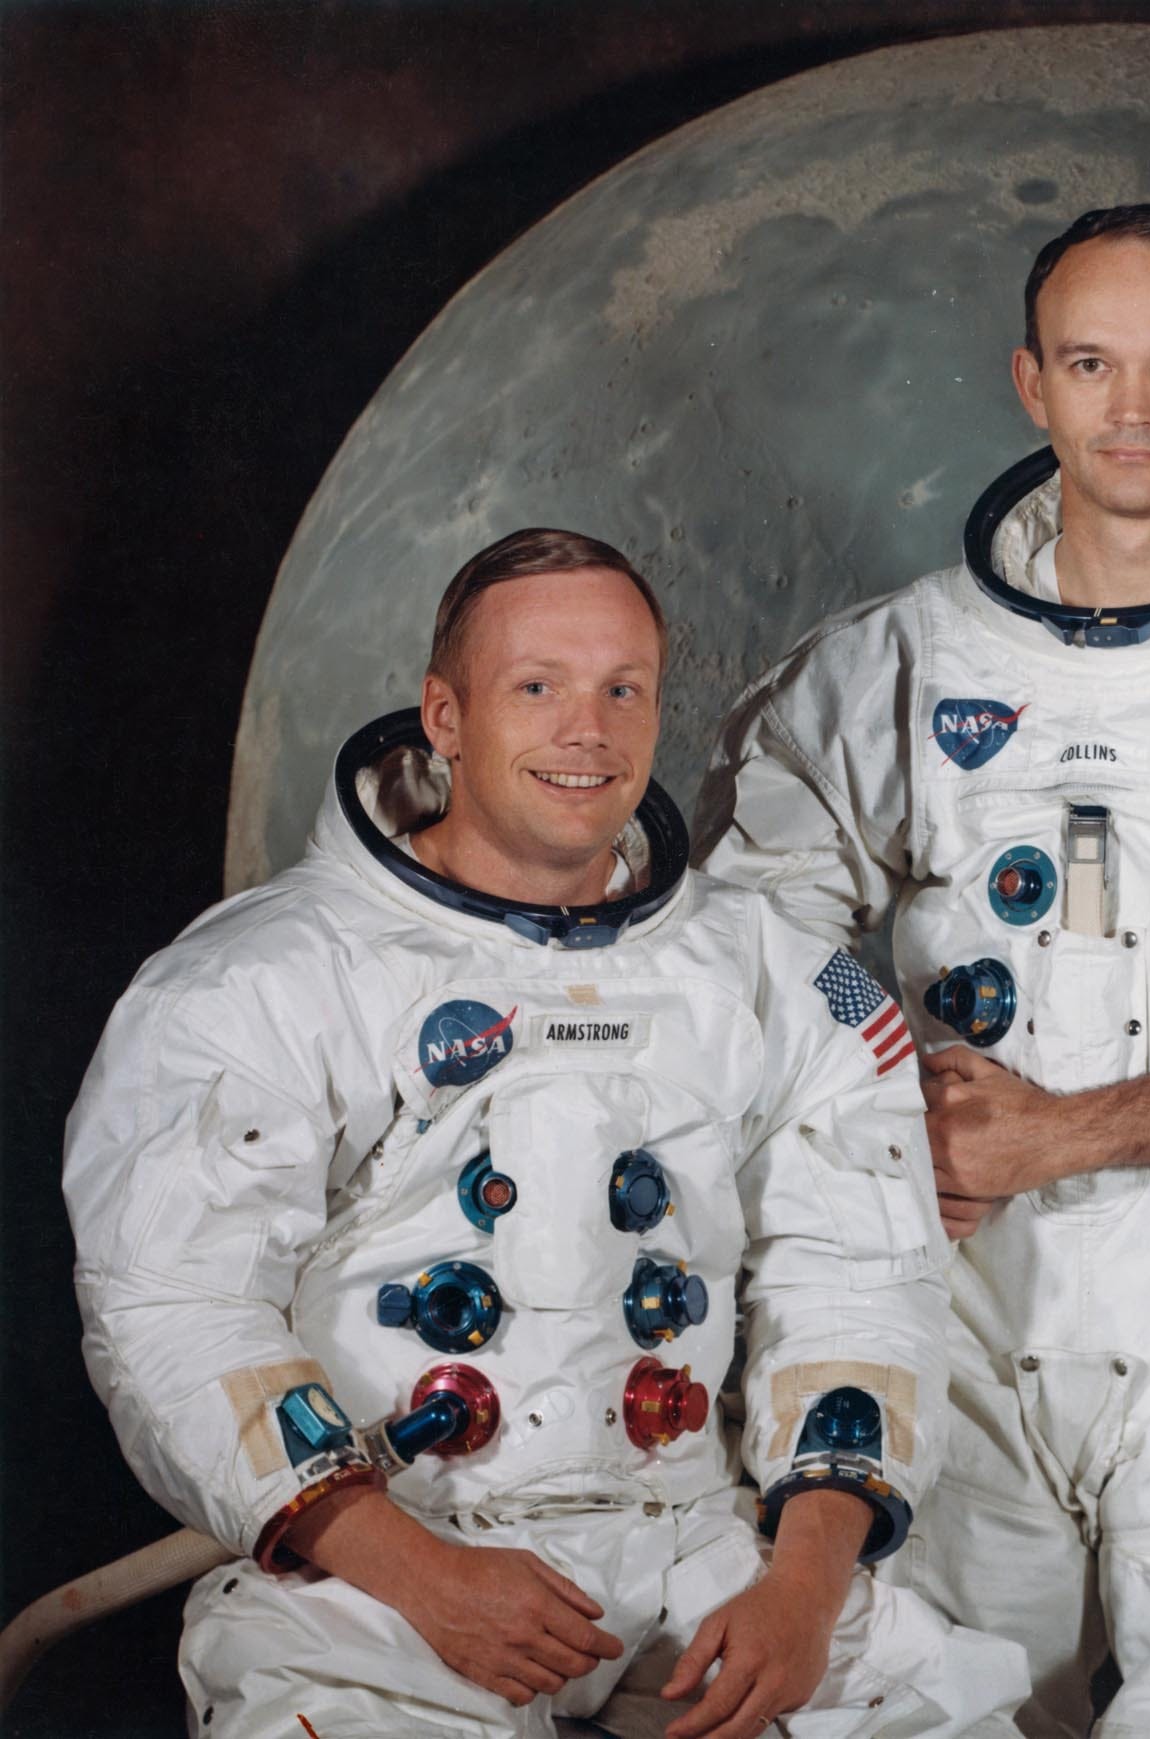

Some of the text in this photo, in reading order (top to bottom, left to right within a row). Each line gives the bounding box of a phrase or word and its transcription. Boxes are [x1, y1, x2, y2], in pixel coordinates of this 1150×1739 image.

[941, 712, 1008, 734] NASA
[1060, 744, 1118, 763] COLLINS
[546, 1022, 629, 1041] ARMSTRONG
[426, 1035, 506, 1064] NASA
